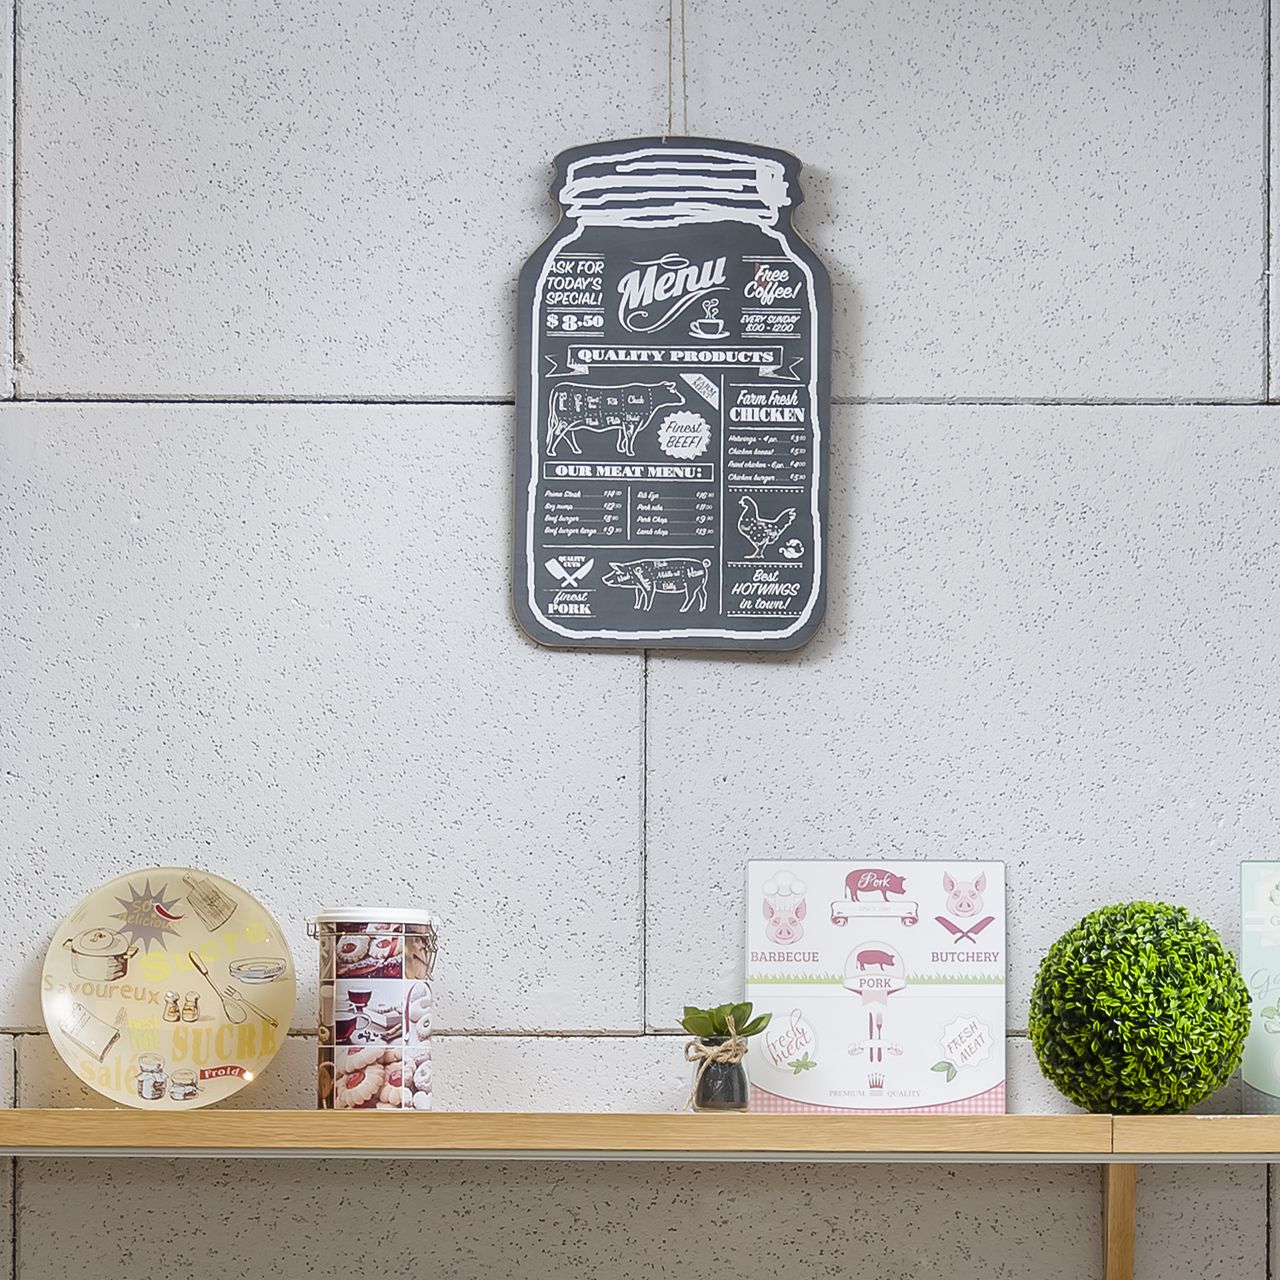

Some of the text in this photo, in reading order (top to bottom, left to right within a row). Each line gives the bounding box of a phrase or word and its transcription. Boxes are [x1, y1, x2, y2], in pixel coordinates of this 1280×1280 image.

[549, 261, 604, 274] ASK FOR
[755, 264, 789, 282] Free
[547, 277, 602, 290] TODAY'S
[618, 256, 726, 310] Menu
[545, 293, 603, 306] SPECIAL!
[744, 282, 802, 306] Coffee!
[740, 315, 800, 324] EVERY SUNDAY
[578, 350, 774, 364] QUALITY PRODUCTS
[737, 390, 798, 405] Farm Fresh
[729, 407, 805, 422] CHICKEN
[666, 421, 701, 433] Finest
[666, 436, 703, 448] BEEF!
[555, 465, 702, 478] OUR MEAT MENU:
[753, 569, 779, 581] Best
[731, 583, 800, 595] HOTWINGS
[554, 591, 588, 603] finest
[740, 597, 791, 609] in town!
[548, 604, 591, 614] PORK
[858, 871, 891, 889] Pork
[751, 952, 819, 962] BARBECUE
[932, 952, 999, 962] BUTCHERY
[859, 978, 892, 988] PORK
[946, 1021, 979, 1055] FRESH
[960, 1035, 987, 1064] MEAT
[204, 1068, 240, 1079] Froid
